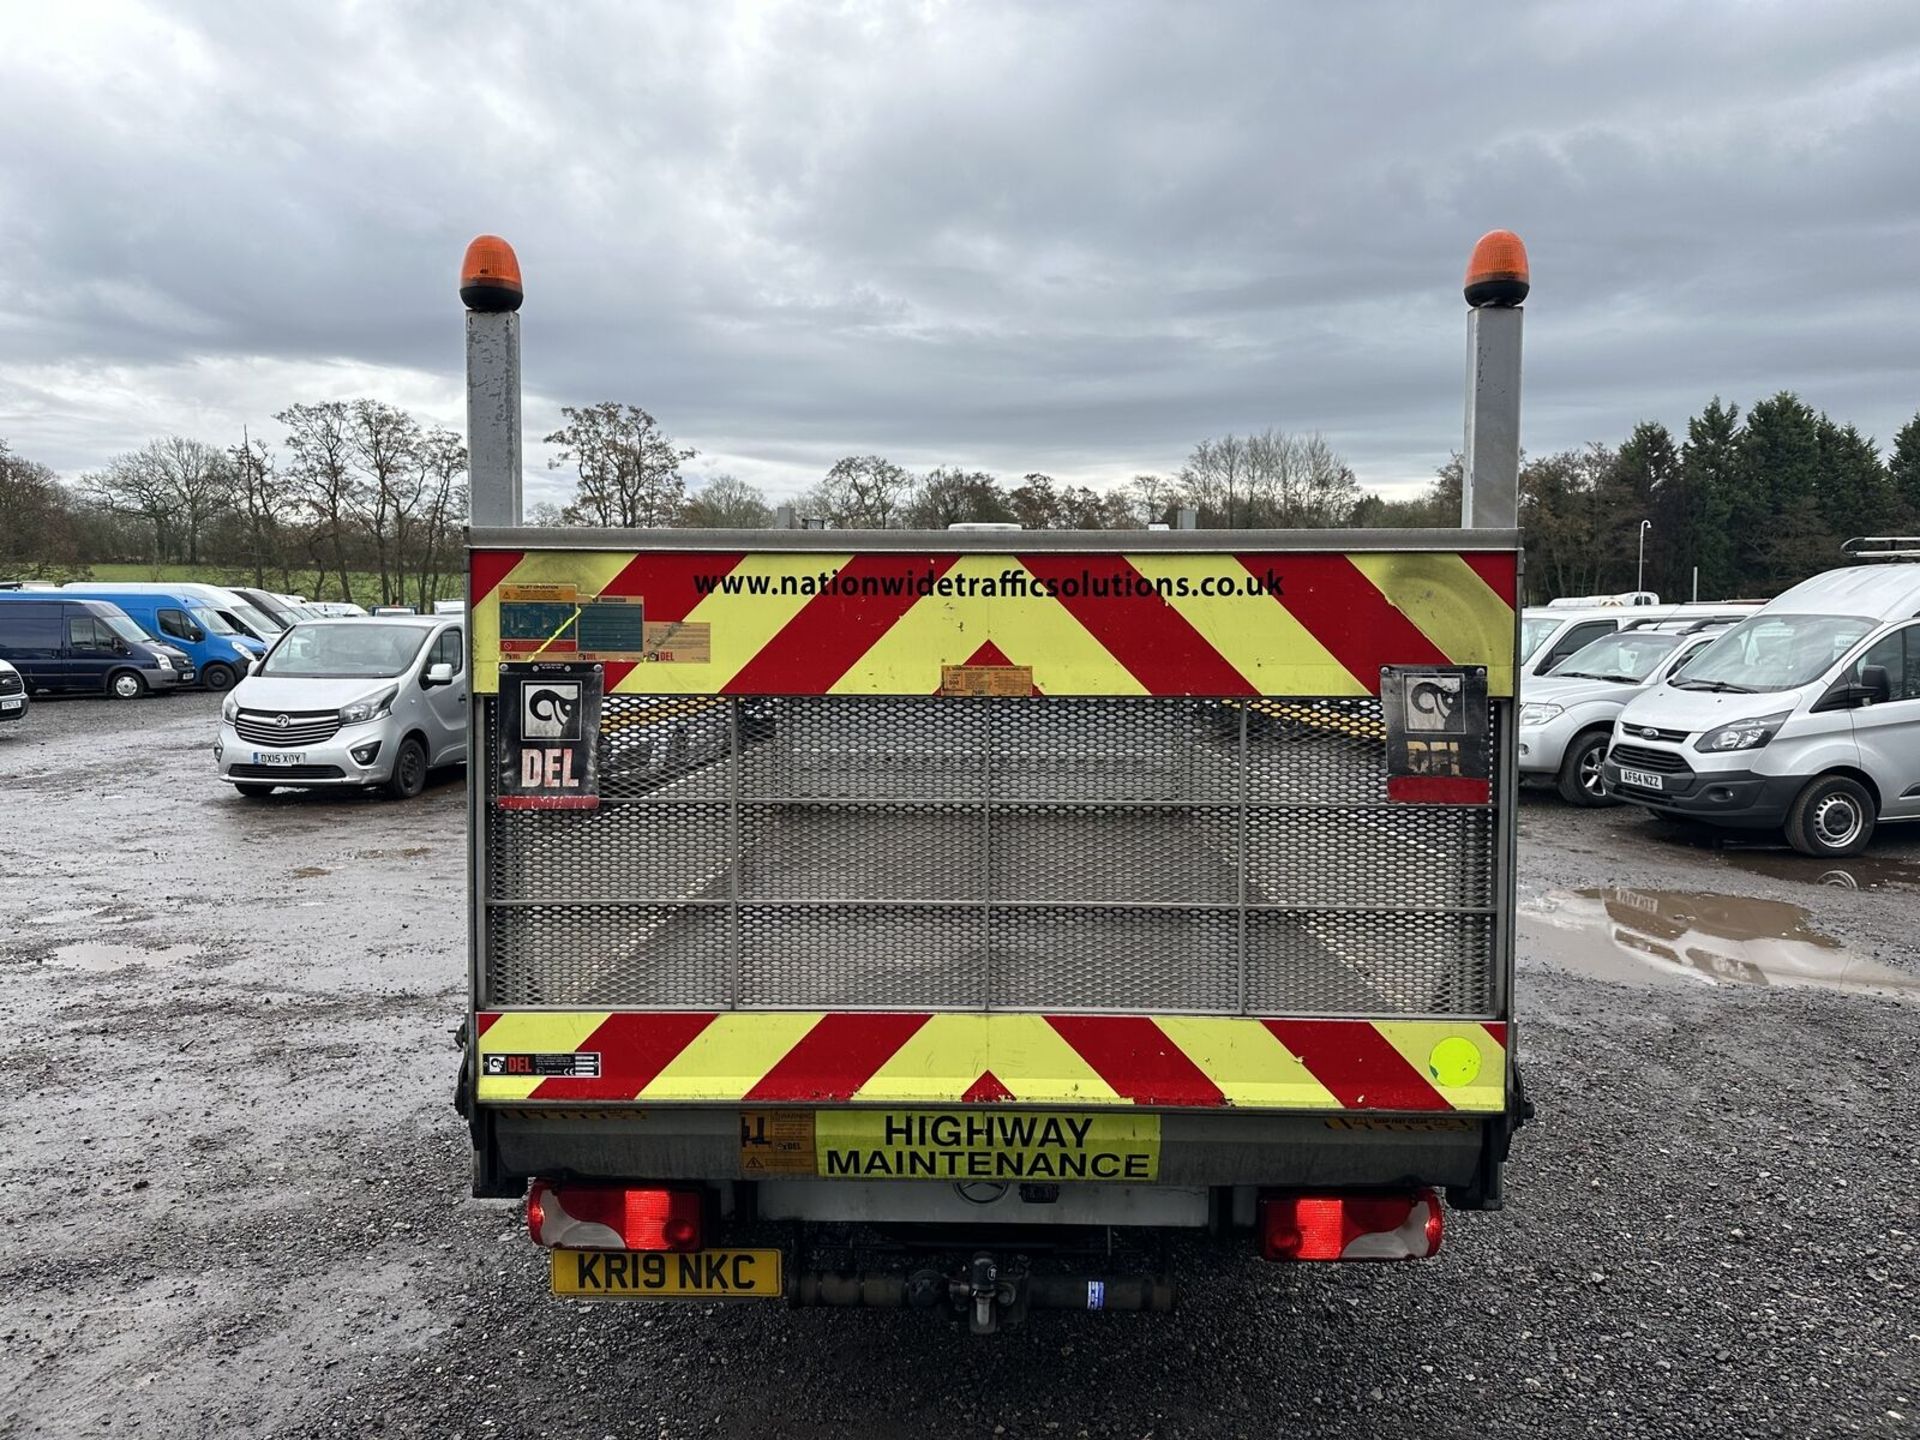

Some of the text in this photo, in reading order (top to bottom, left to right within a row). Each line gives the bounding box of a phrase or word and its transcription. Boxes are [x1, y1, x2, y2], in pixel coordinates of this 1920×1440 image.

[693, 568, 1285, 597] www.nationwidetrafficsolutions.co.uk
[660, 651, 674, 661] DEL
[260, 754, 281, 763] DX15
[521, 748, 580, 788] DEL
[1624, 771, 1660, 787] AF64 NZZ
[507, 1056, 532, 1073] DEL
[885, 1115, 1093, 1148] HIGHWAY
[827, 1150, 1150, 1178] MAINTENANCE
[578, 1253, 755, 1290] KR19 NKC
